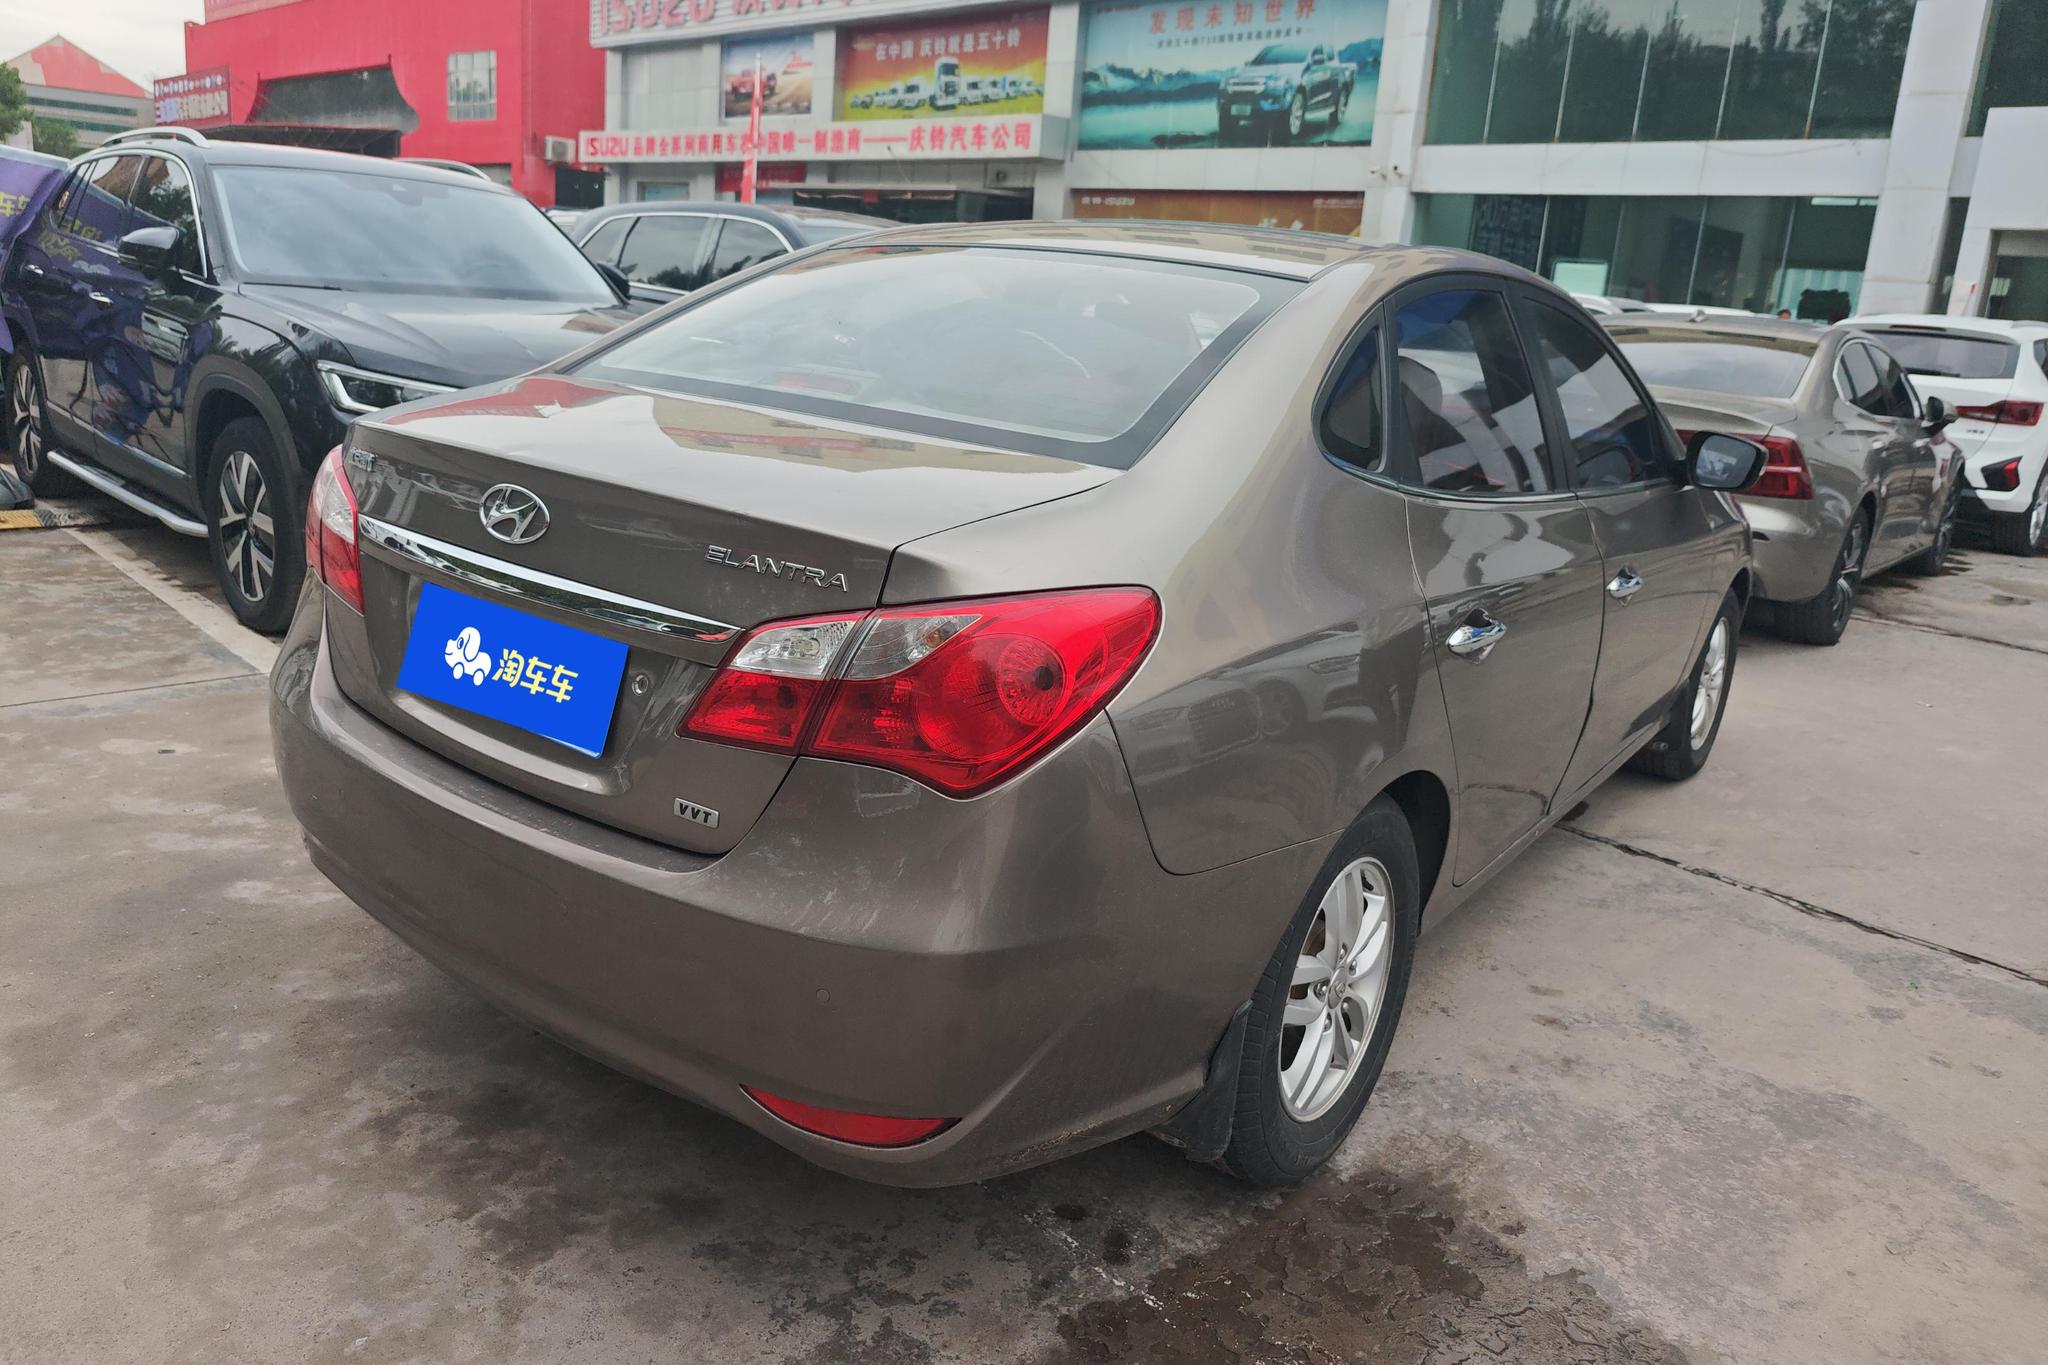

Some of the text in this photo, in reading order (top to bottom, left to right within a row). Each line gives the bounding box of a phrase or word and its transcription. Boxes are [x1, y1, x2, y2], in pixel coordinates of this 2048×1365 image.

[1150, 0, 1316, 34] 发现未知世界
[876, 40, 914, 62] 在中国
[706, 545, 848, 593] ELANTRA
[679, 802, 712, 824] VVT
